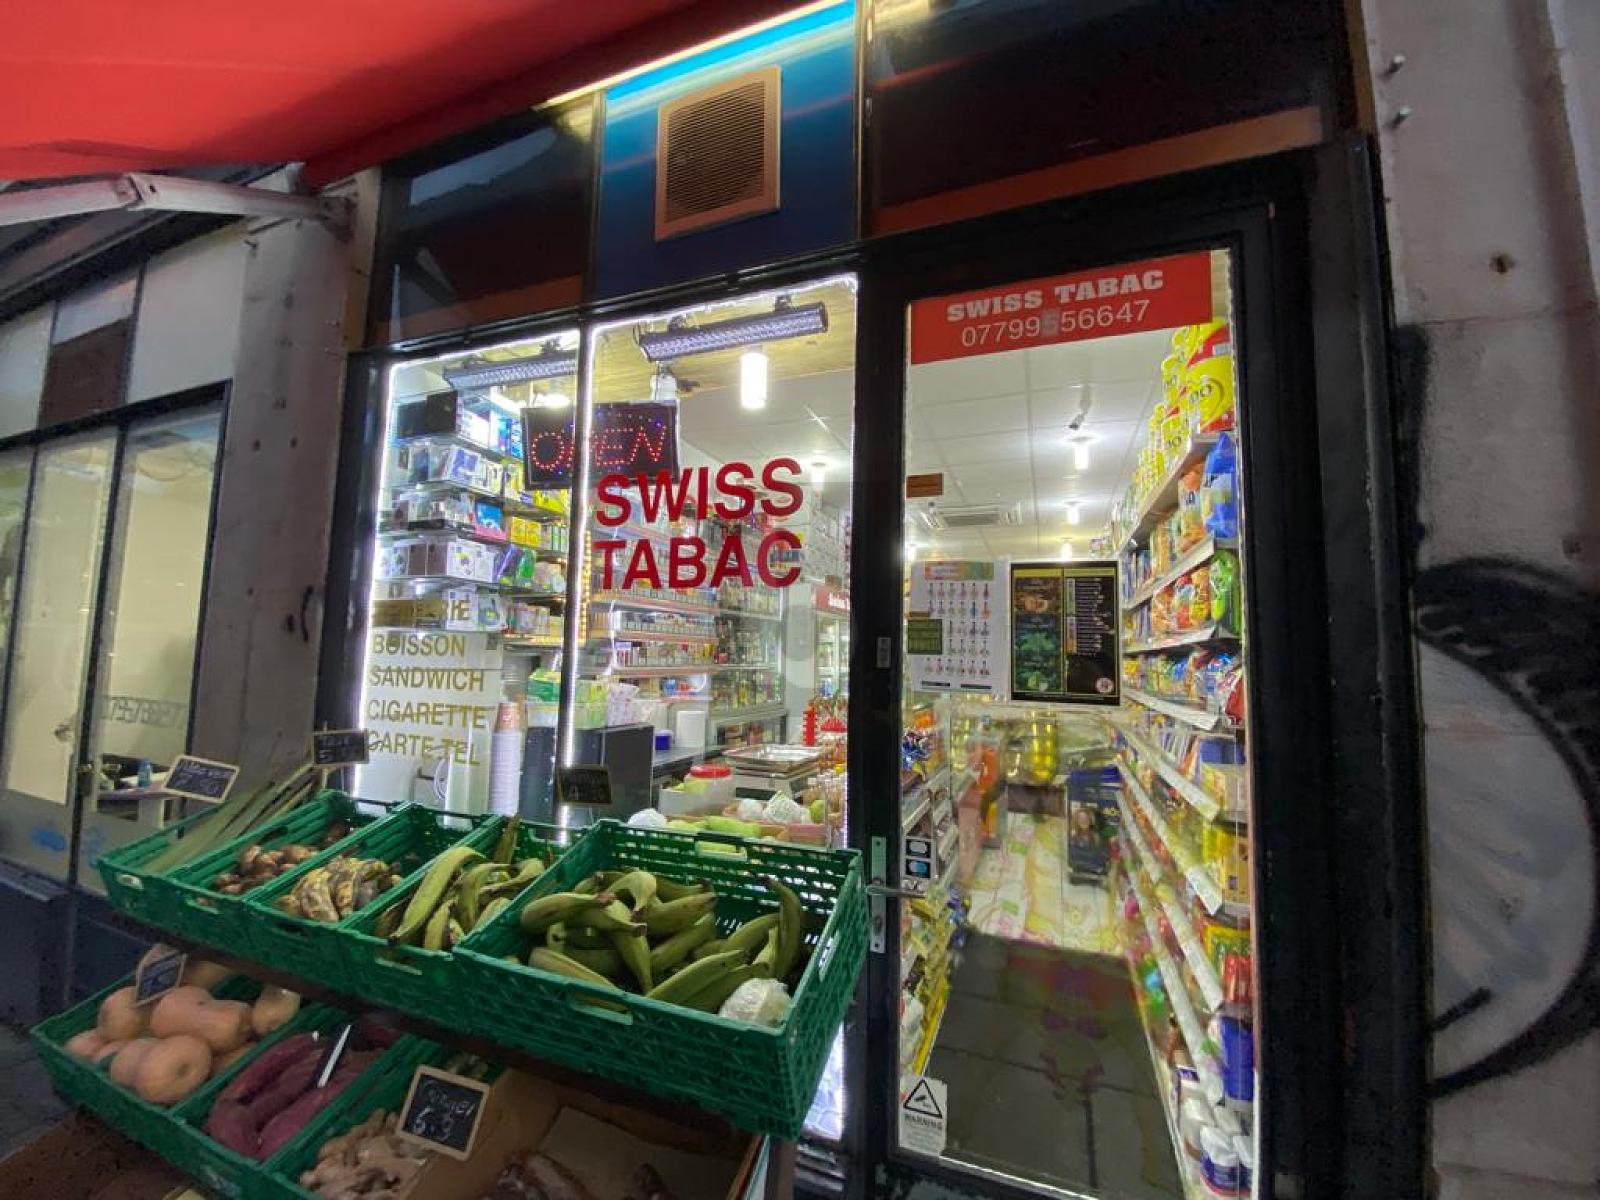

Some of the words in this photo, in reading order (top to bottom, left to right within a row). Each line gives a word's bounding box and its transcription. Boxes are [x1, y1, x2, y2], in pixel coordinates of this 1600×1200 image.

[947, 289, 1043, 322] SWISS
[1054, 270, 1164, 303] TABAC
[595, 457, 804, 527] SWISS
[592, 529, 802, 590] TABAC
[371, 633, 466, 658] BOISSON
[369, 665, 485, 692] SANDWICH
[368, 699, 487, 729] CIGARETTE
[369, 730, 434, 760] CARTE
